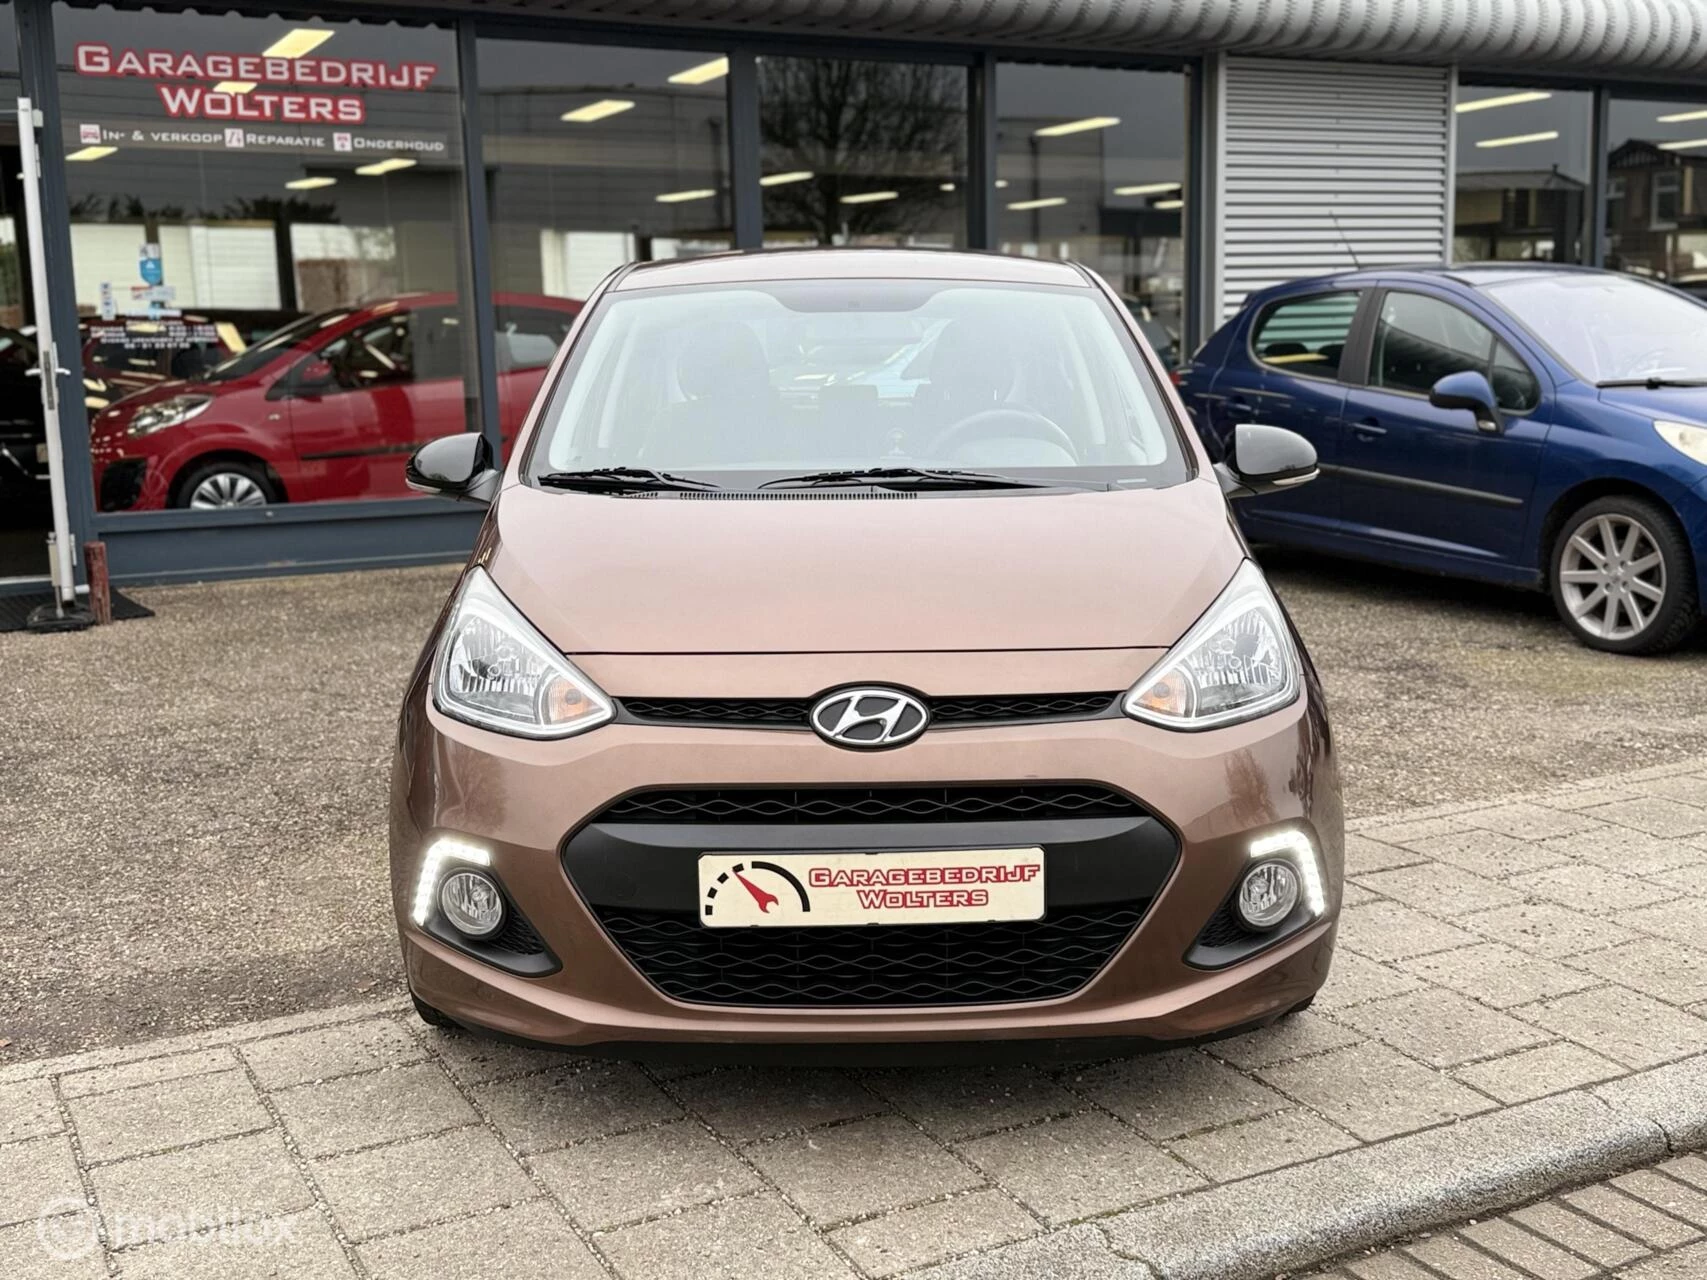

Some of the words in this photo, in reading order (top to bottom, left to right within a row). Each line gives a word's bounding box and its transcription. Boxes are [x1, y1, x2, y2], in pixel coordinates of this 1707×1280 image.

[76, 43, 437, 88] GARAGEBEDRIJF
[159, 85, 364, 122] WOLTERS
[131, 130, 145, 141] &
[151, 132, 223, 143] VERKOOP
[246, 133, 325, 147] REPARATIE
[353, 137, 444, 151] ONDERHOUD
[808, 864, 1041, 887] GARAGEBEDRIJF
[857, 890, 989, 909] WOLTERS
